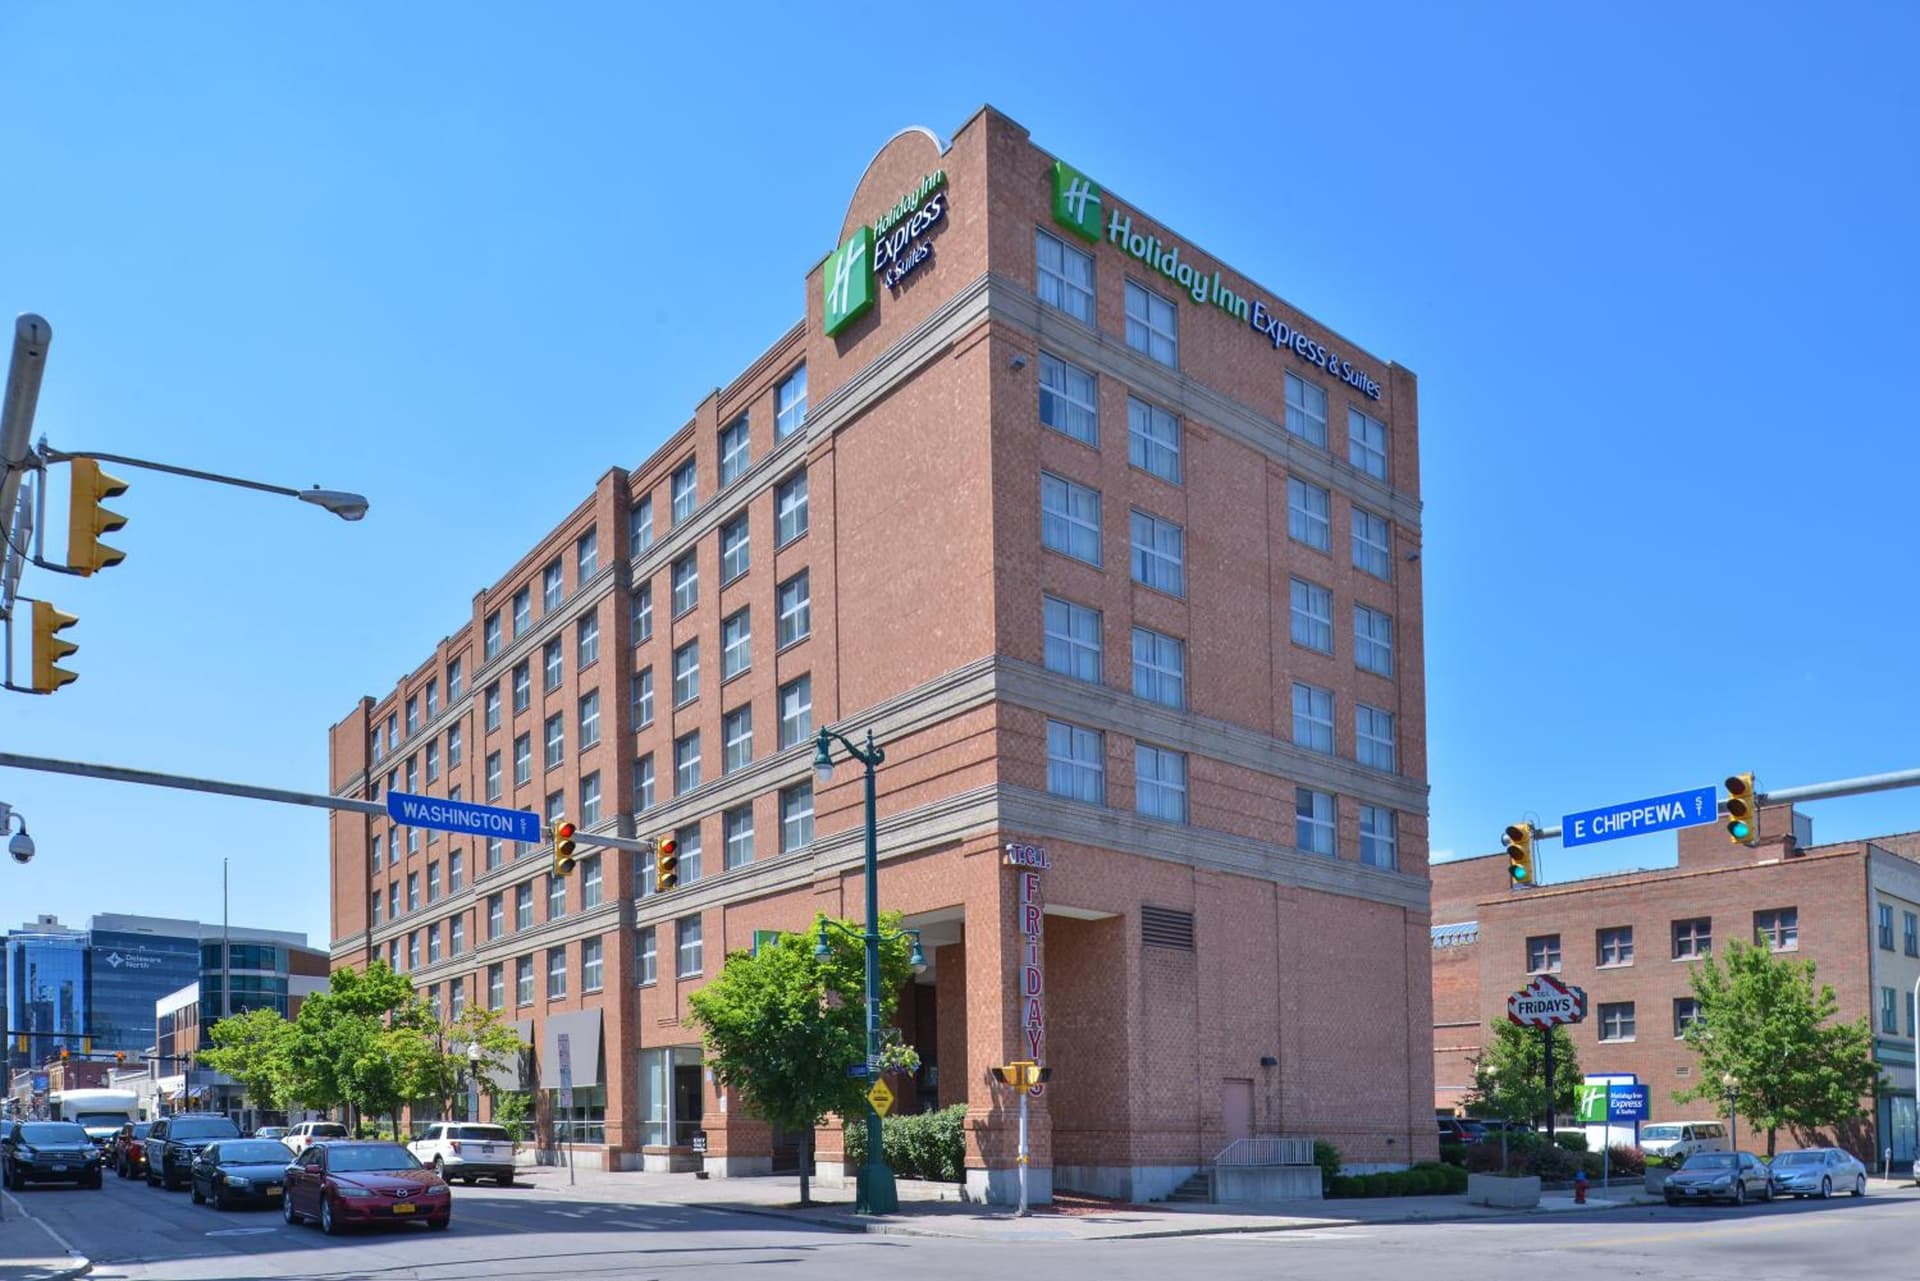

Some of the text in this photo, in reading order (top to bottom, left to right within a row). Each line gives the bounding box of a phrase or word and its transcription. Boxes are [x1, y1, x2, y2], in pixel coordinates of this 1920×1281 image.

[873, 168, 941, 241] Holiday Inn
[874, 192, 943, 272] Express
[885, 240, 929, 289] & Suites
[1107, 209, 1382, 400] Holiday Inn Express & Suites
[402, 801, 514, 833] WASHINGTON
[1574, 820, 1586, 838] E
[1592, 801, 1686, 835] CHIPPEWA
[1610, 1099, 1643, 1108] Express
